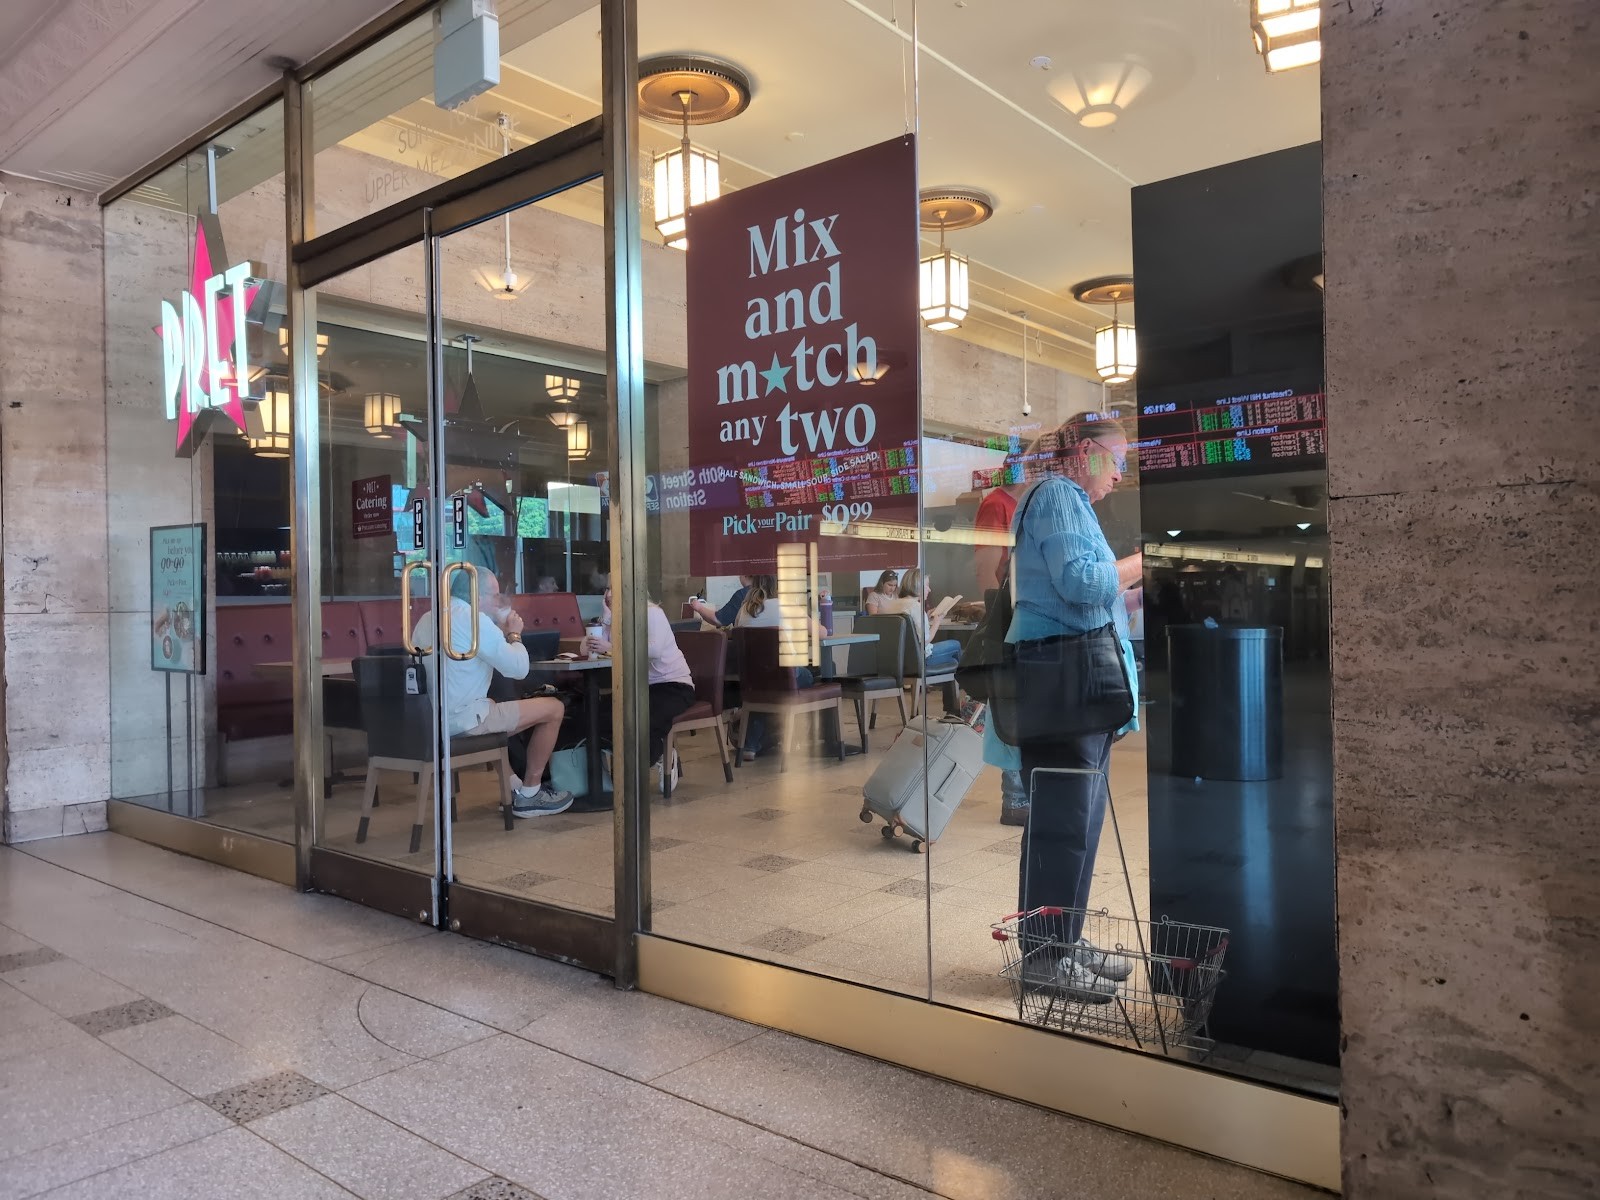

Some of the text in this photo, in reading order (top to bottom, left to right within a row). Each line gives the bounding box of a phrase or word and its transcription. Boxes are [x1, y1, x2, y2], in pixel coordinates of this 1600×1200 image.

[365, 170, 410, 204] UPPER
[746, 208, 842, 279] Mix
[744, 261, 843, 340] and
[161, 260, 250, 420] PRET
[716, 322, 878, 406] mtch
[719, 401, 877, 456] any two
[356, 495, 387, 511] Catering
[720, 469, 738, 478] HALF
[780, 480, 806, 490] SMALL
[455, 499, 463, 545] PULL
[722, 513, 758, 536] Pick
[758, 517, 775, 529] your
[775, 508, 813, 532] Pair
